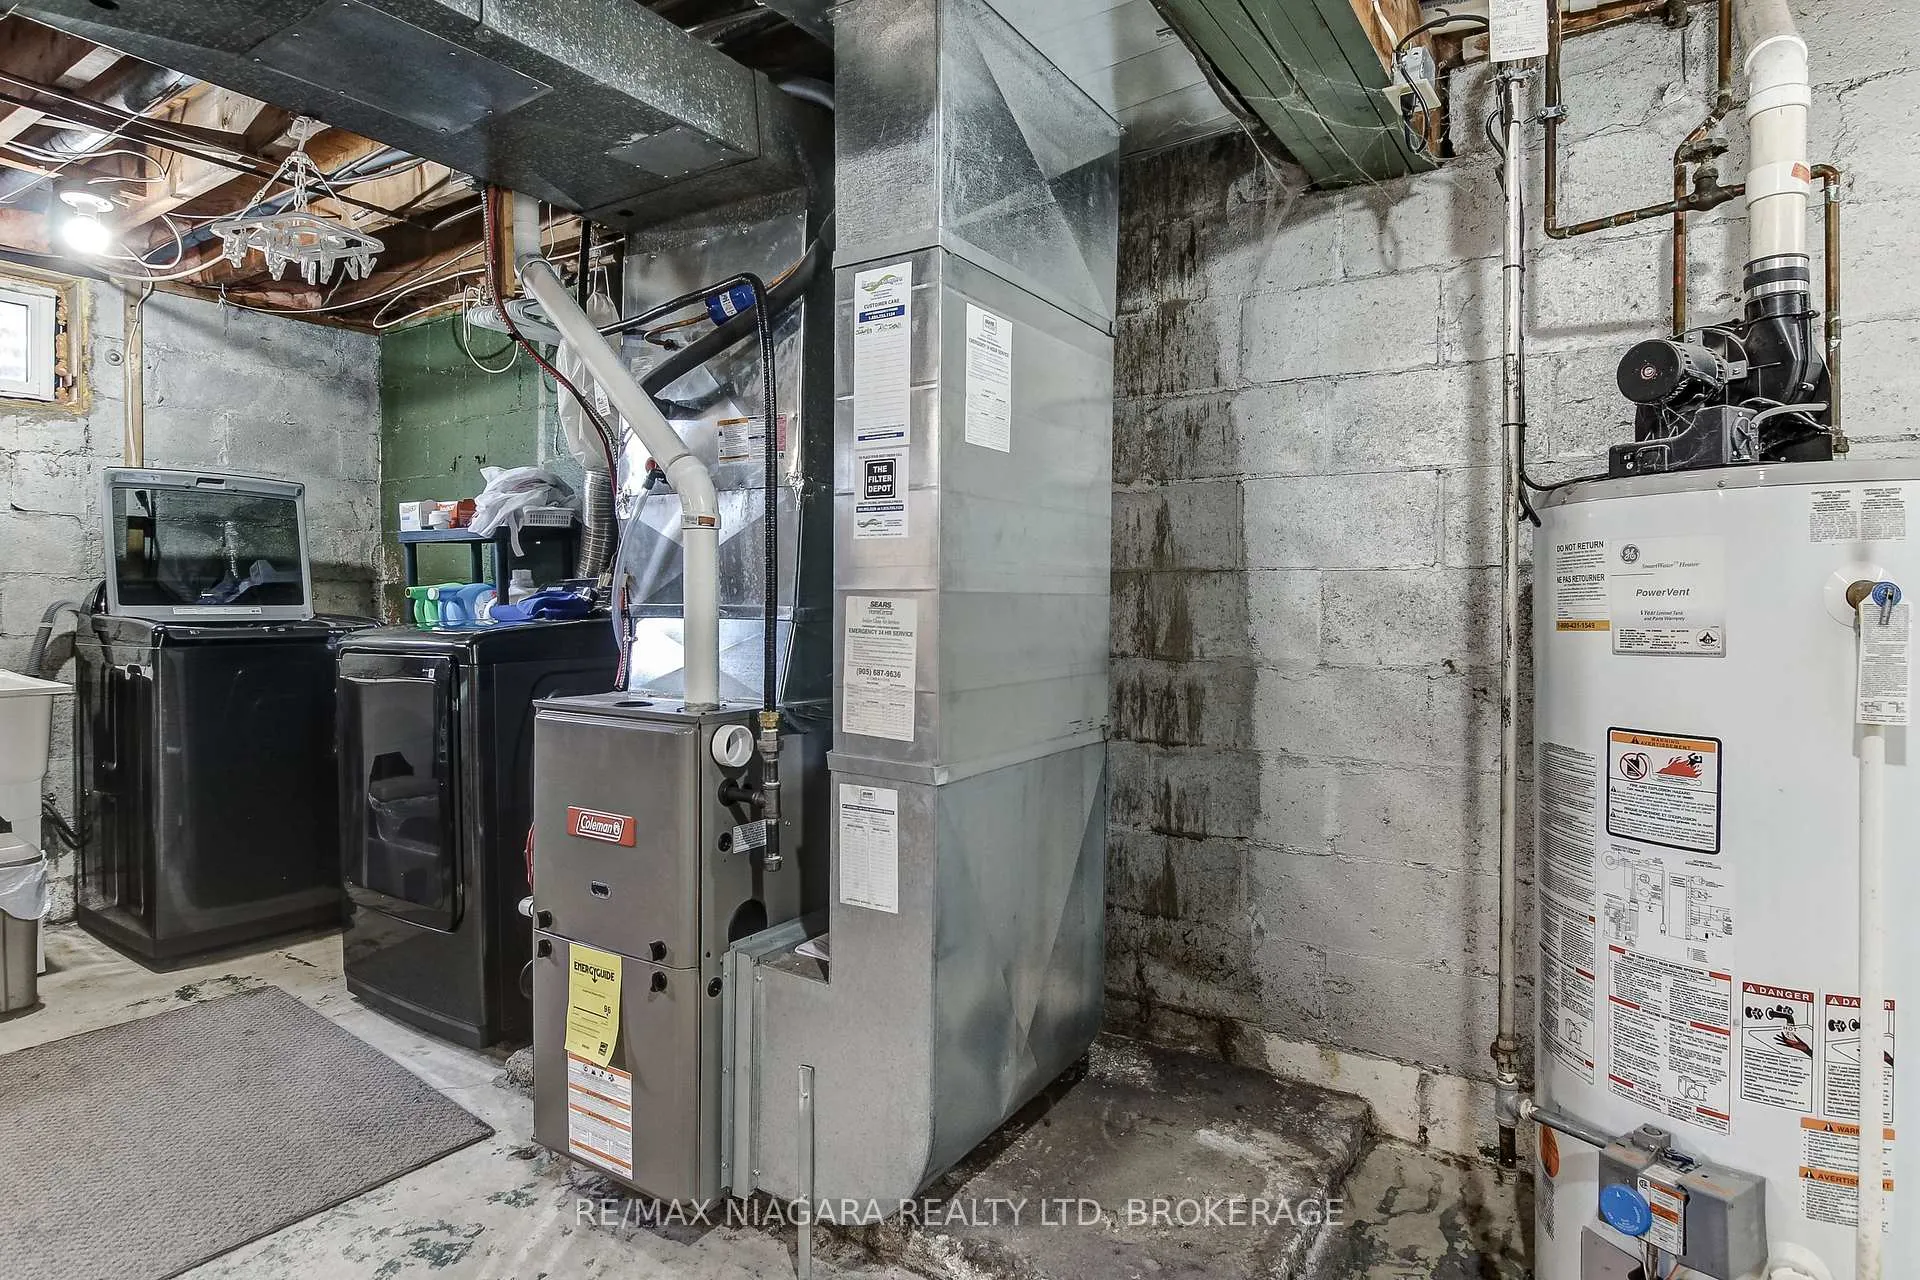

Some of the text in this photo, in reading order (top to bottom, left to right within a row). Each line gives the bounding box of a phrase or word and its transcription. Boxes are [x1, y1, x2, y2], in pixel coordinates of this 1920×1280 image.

[863, 301, 887, 310] CUSTOMER
[872, 465, 888, 474] THE
[867, 475, 893, 484] FILTER
[867, 484, 893, 494] DEPOT
[1556, 540, 1604, 553] DO NOT RETURN
[1562, 575, 1571, 583] PAS
[1571, 573, 1605, 583] RETOURNER
[1635, 588, 1690, 597] PowerVent
[848, 627, 878, 635] EMERGENCY
[856, 667, 872, 677] (905)
[1640, 741, 1692, 750] AVERTISSEMENT
[1650, 736, 1680, 745] WARNING
[580, 814, 613, 834] Coleman
[1758, 985, 1811, 1001] DANGER
[1842, 996, 1892, 1010] DAR
[603, 1004, 612, 1015] 96
